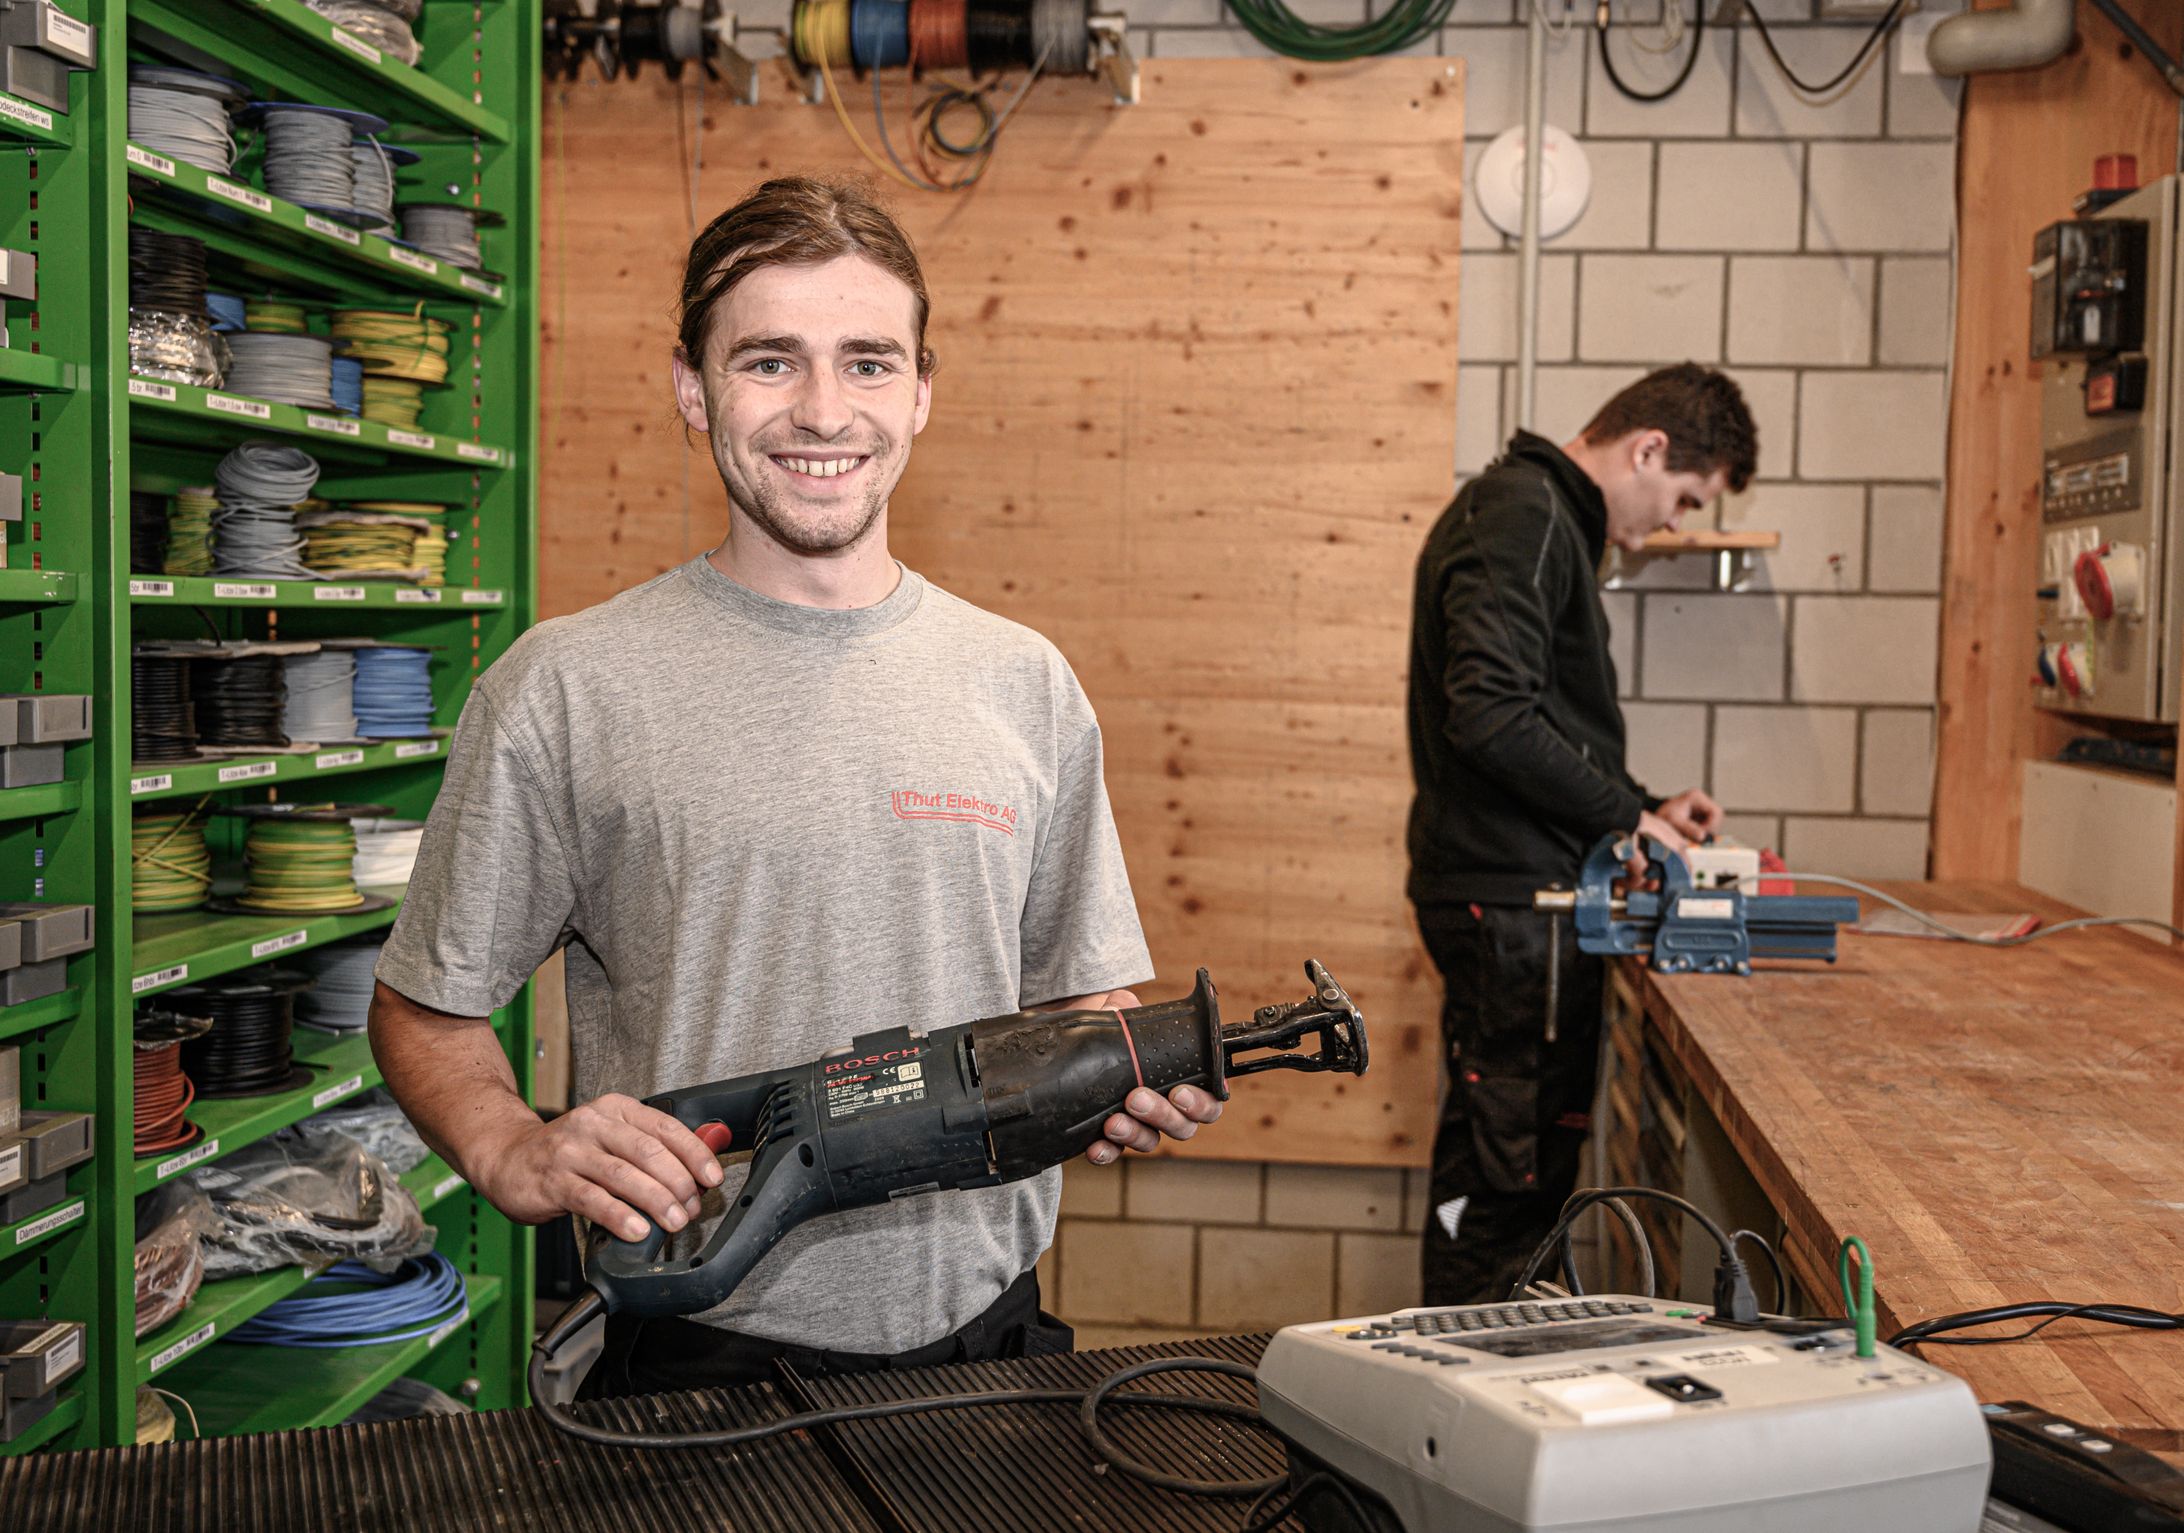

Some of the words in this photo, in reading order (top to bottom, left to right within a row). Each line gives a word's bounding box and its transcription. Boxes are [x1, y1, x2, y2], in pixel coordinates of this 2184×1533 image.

[902, 791, 941, 807] Thut
[946, 793, 999, 815] Elektro
[1001, 805, 1017, 824] AG
[825, 1047, 920, 1074] BOSCH
